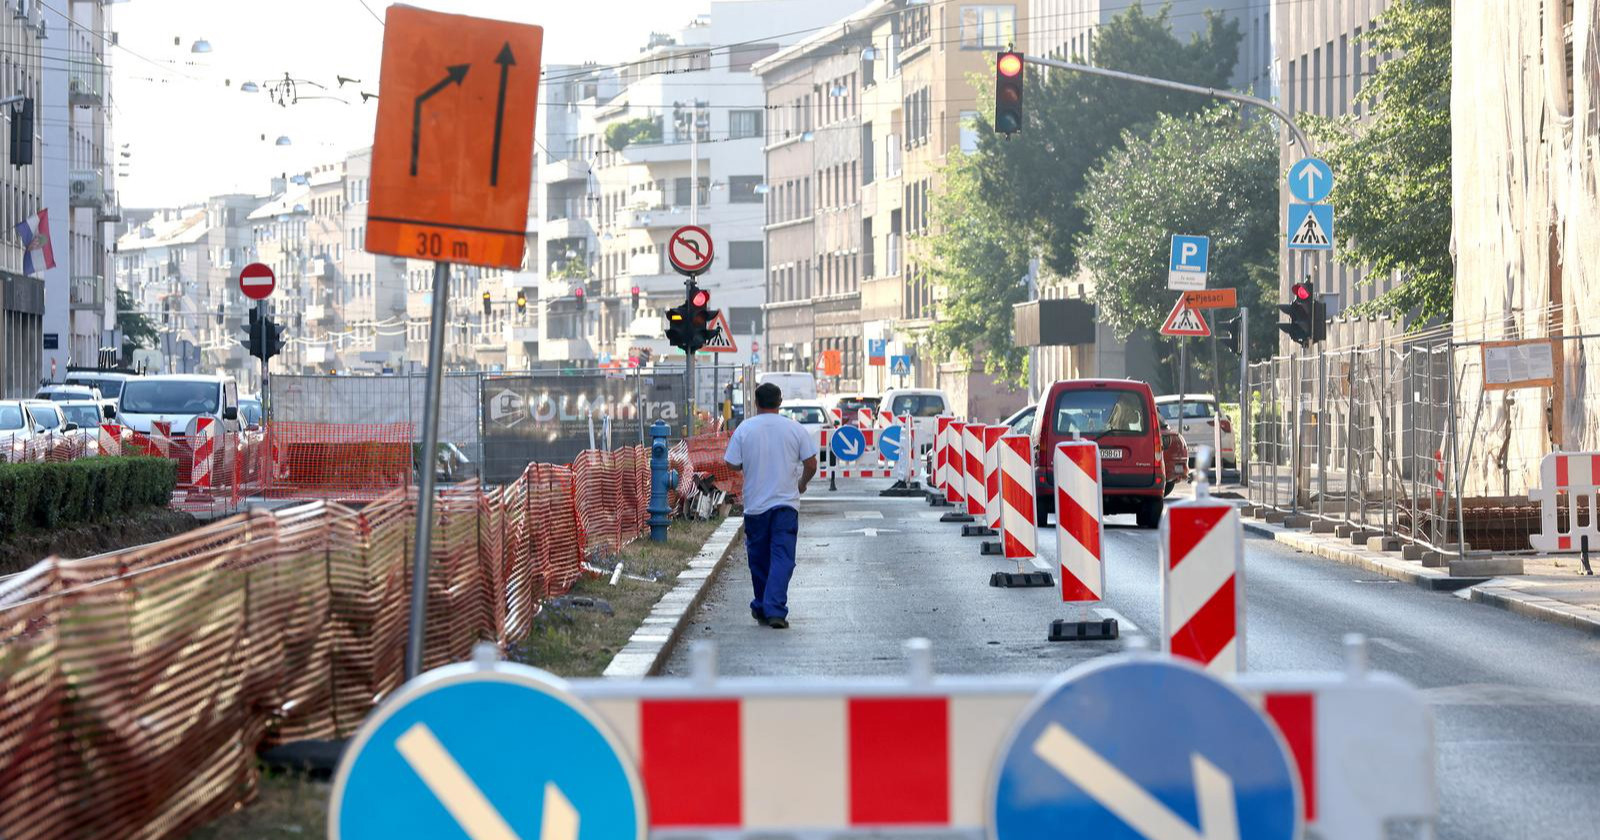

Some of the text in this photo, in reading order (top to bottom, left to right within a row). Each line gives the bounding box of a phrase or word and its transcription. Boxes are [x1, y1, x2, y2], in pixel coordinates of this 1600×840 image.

[416, 232, 468, 258] 30 m
[1182, 242, 1198, 265] P
[872, 340, 881, 352] P
